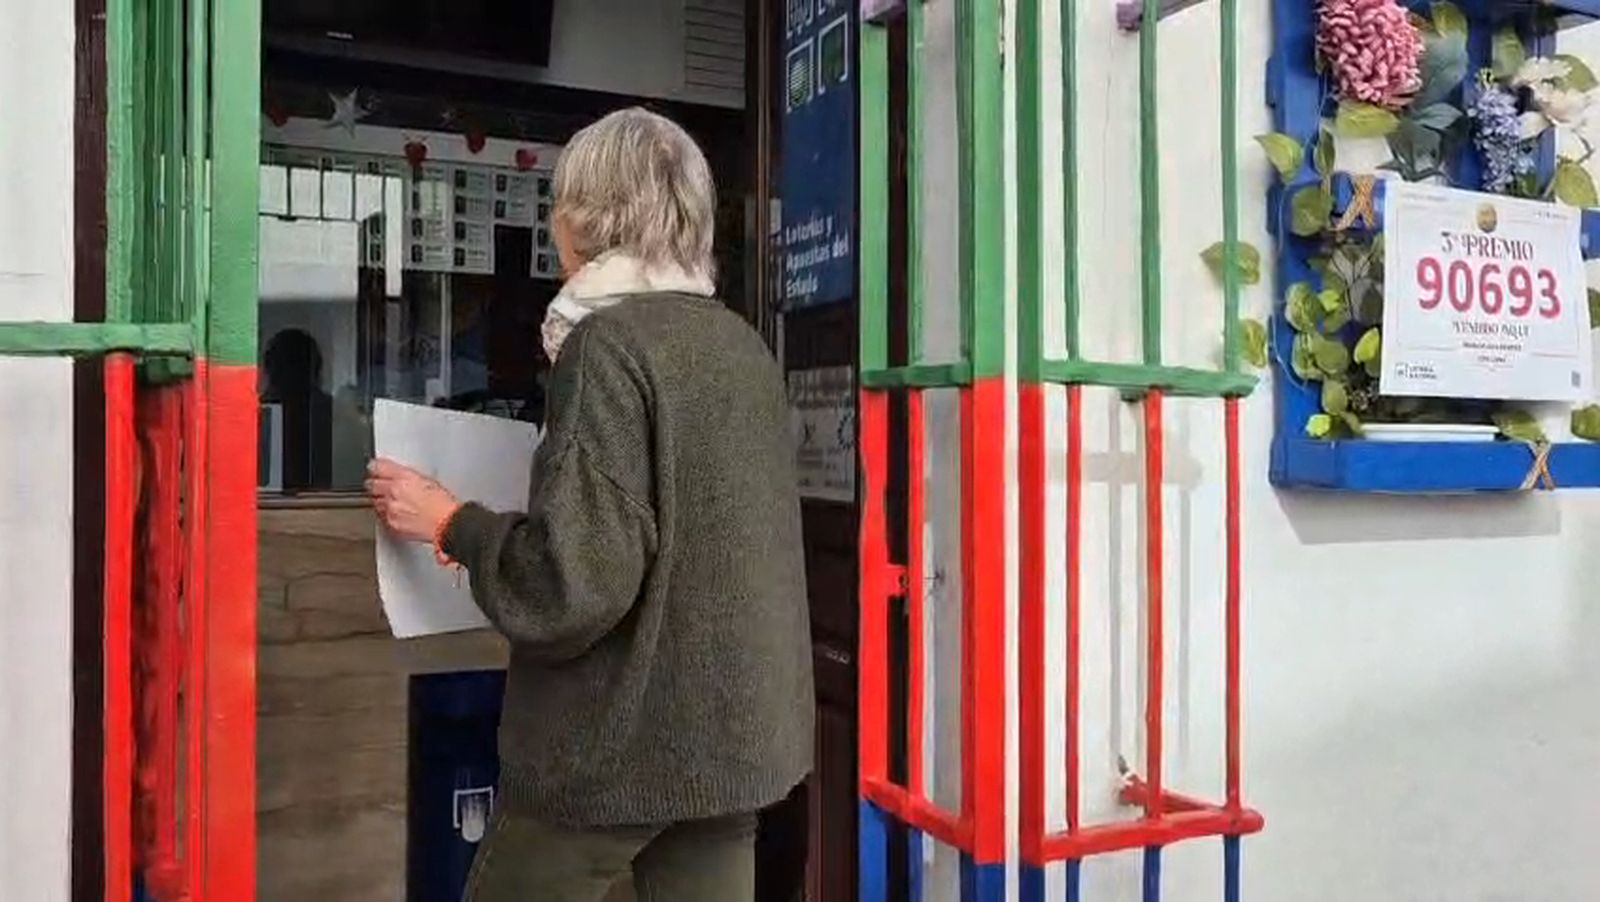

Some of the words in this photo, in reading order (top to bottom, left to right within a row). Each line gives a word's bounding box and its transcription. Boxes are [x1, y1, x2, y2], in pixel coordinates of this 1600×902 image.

[832, 230, 849, 258] del
[1460, 233, 1534, 260] PREMIO
[1416, 256, 1562, 319] 90693
